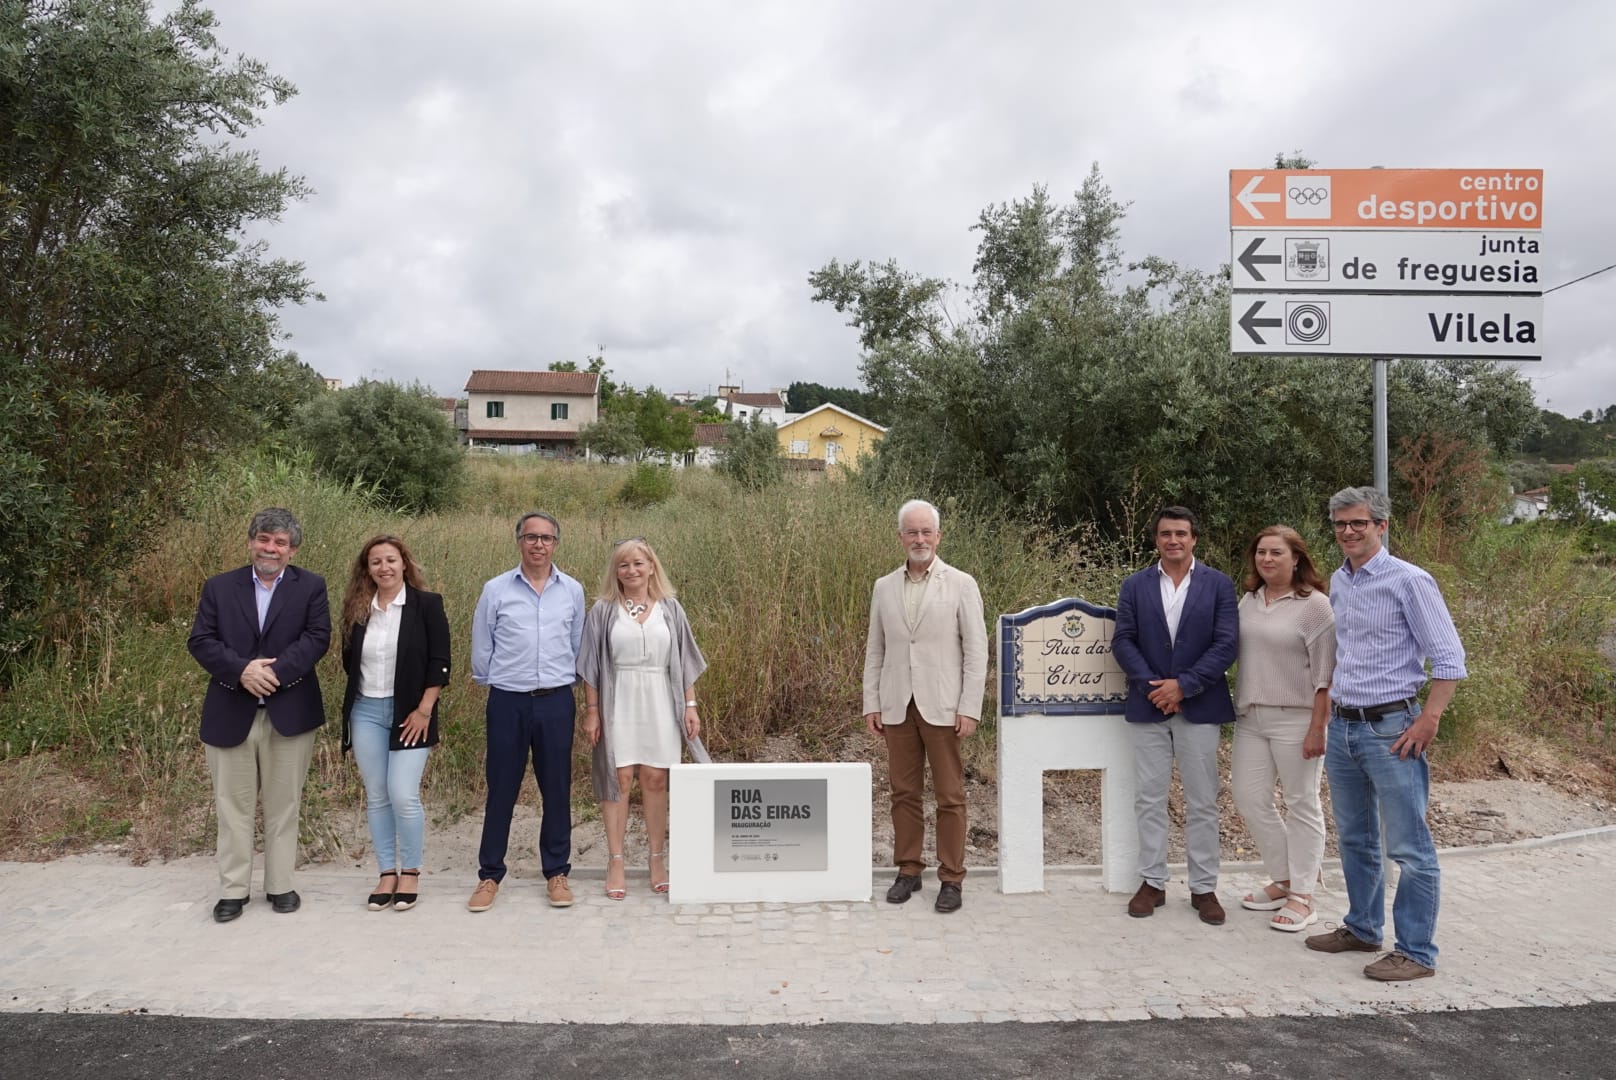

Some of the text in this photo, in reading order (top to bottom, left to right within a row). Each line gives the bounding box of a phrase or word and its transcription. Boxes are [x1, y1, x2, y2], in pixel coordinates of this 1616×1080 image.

[1459, 172, 1539, 191] centro
[1357, 194, 1538, 225] desportivo
[1479, 235, 1540, 256] junta
[1342, 257, 1538, 286] de freguesia
[1428, 312, 1536, 343] Vilela
[1041, 639, 1112, 656] Rua das
[1047, 664, 1104, 685] Eiras
[731, 789, 762, 803] RUA
[731, 804, 811, 820] DAS EIRAS
[731, 821, 772, 829] INAUGURAÇÃO
